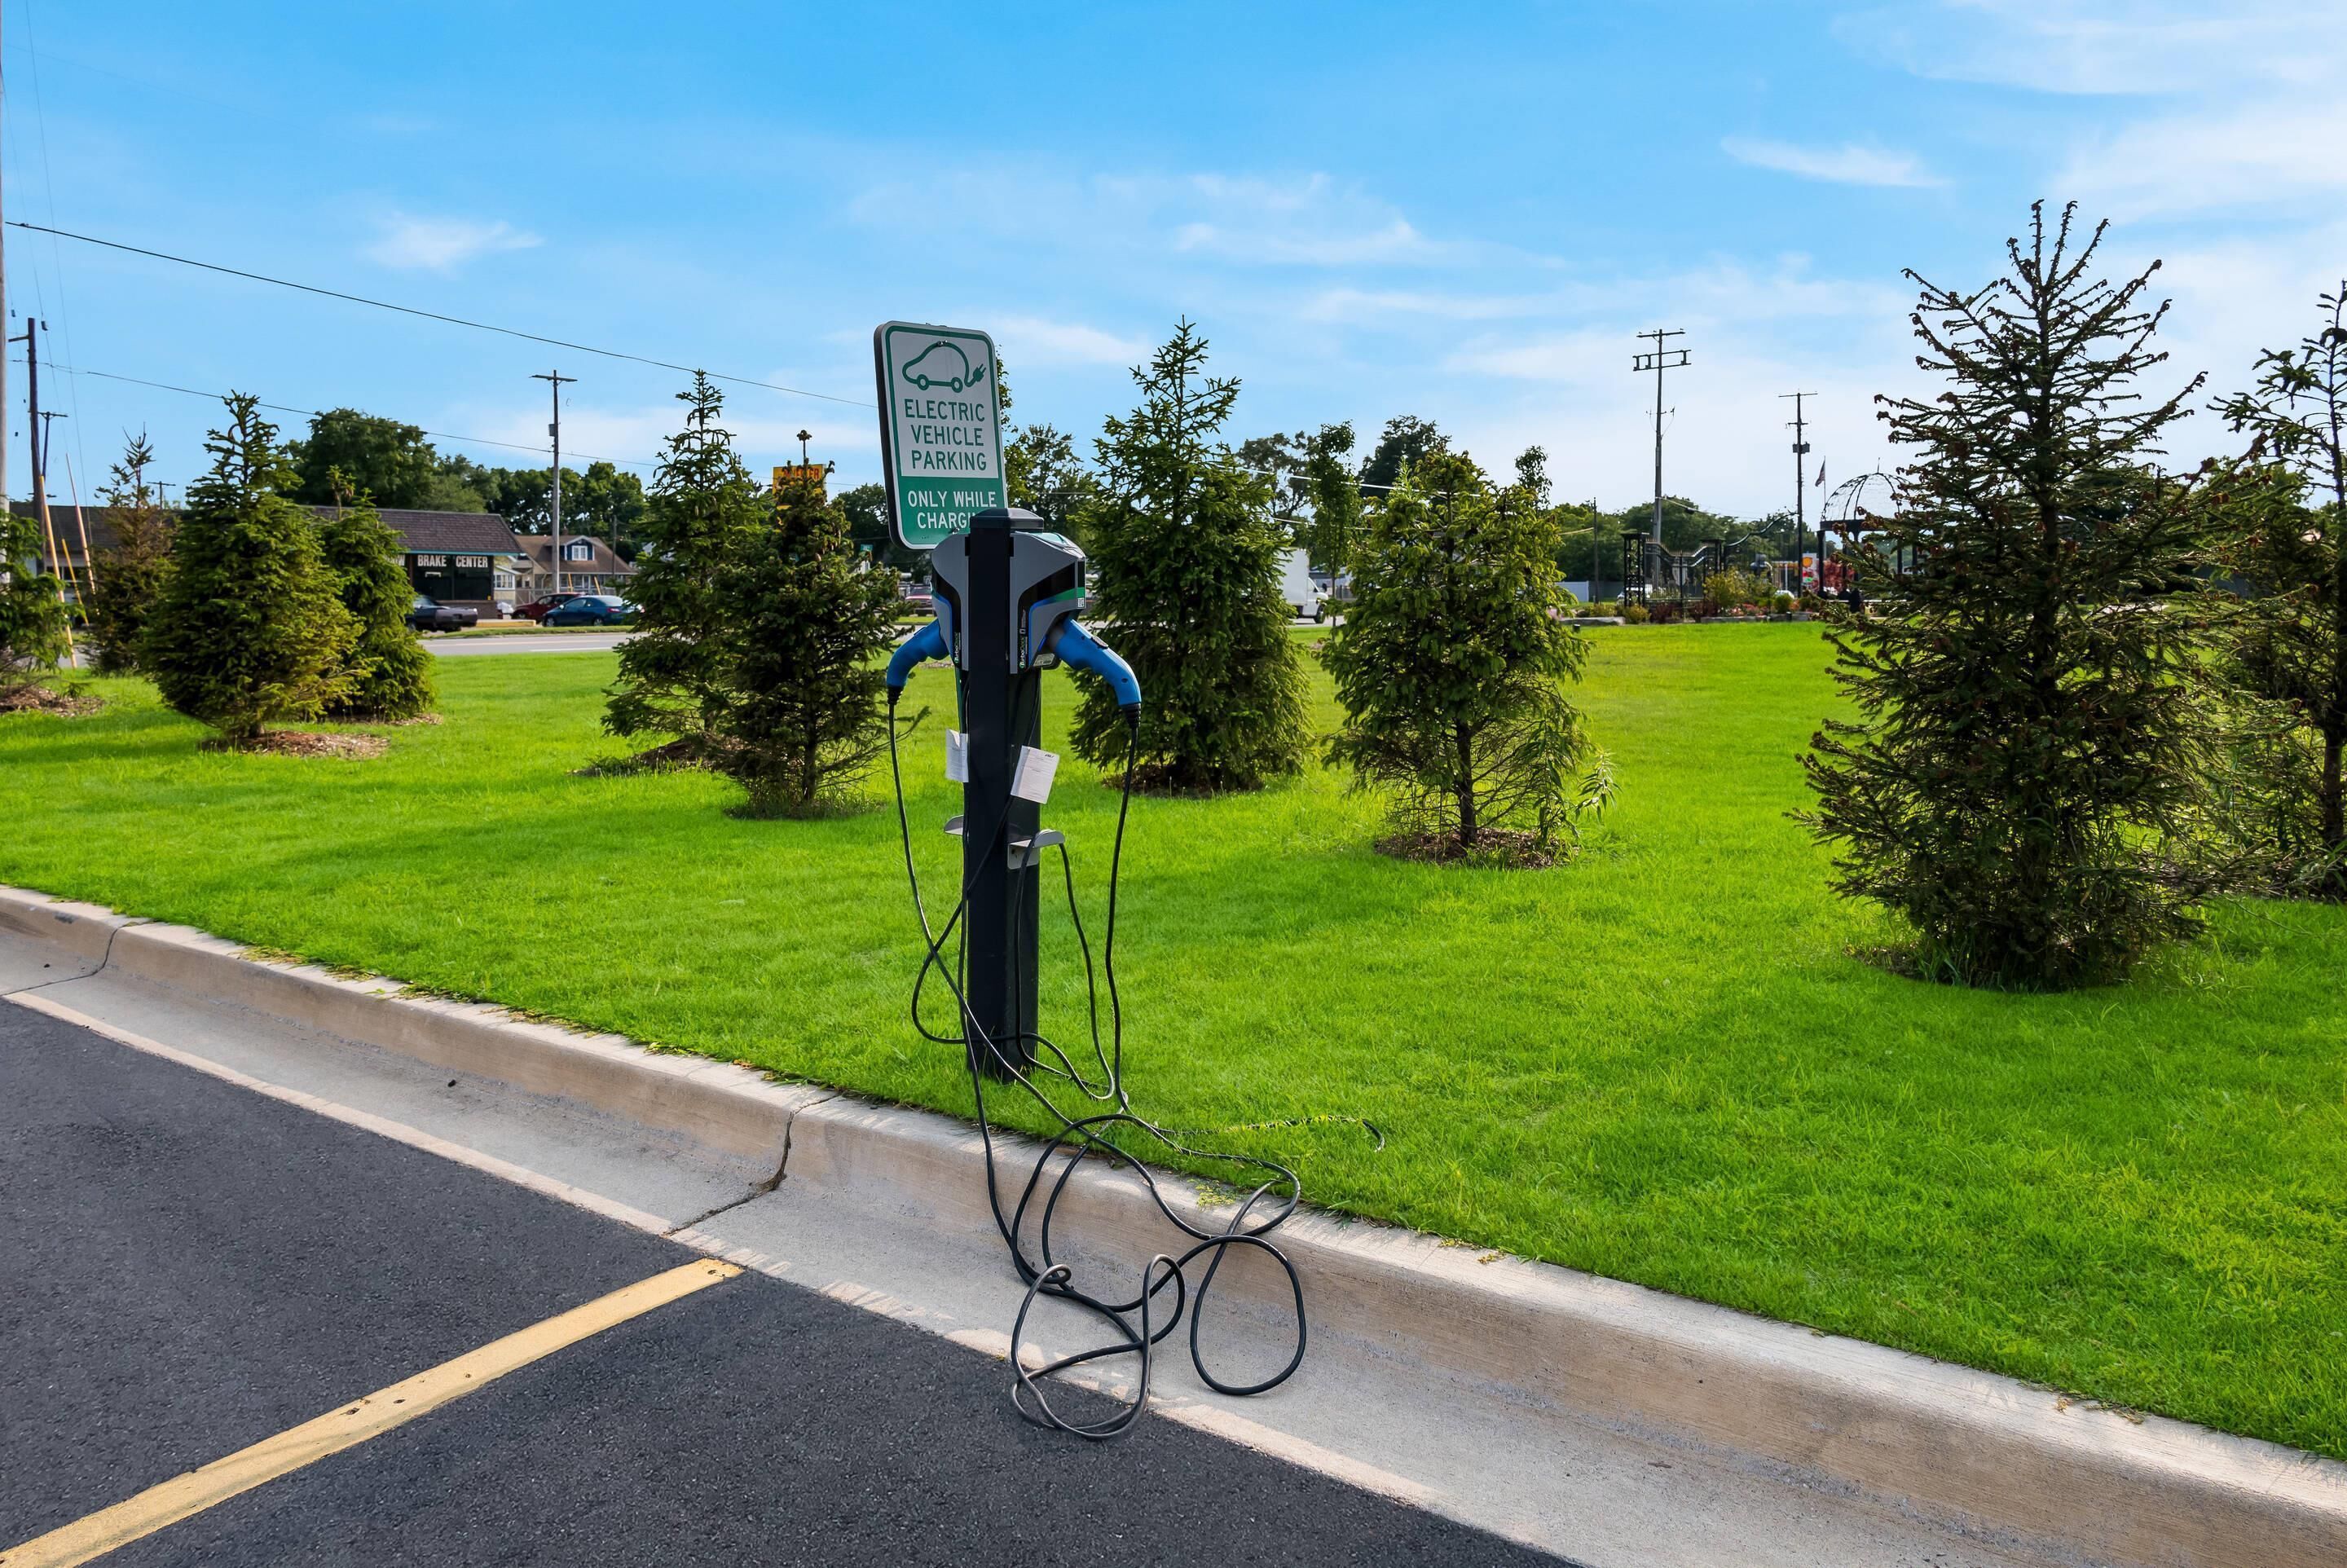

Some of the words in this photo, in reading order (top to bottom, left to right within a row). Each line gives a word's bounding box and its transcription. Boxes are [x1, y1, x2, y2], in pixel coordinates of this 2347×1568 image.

[905, 399, 985, 422] ELECTRIC
[910, 424, 984, 447] VEHICLE
[911, 450, 987, 471] PARKING
[908, 491, 947, 508] ONLY
[953, 491, 997, 508] WHILE
[917, 512, 975, 529] CHARGI
[417, 555, 447, 567] BRAKE
[456, 556, 489, 568] CENTER
